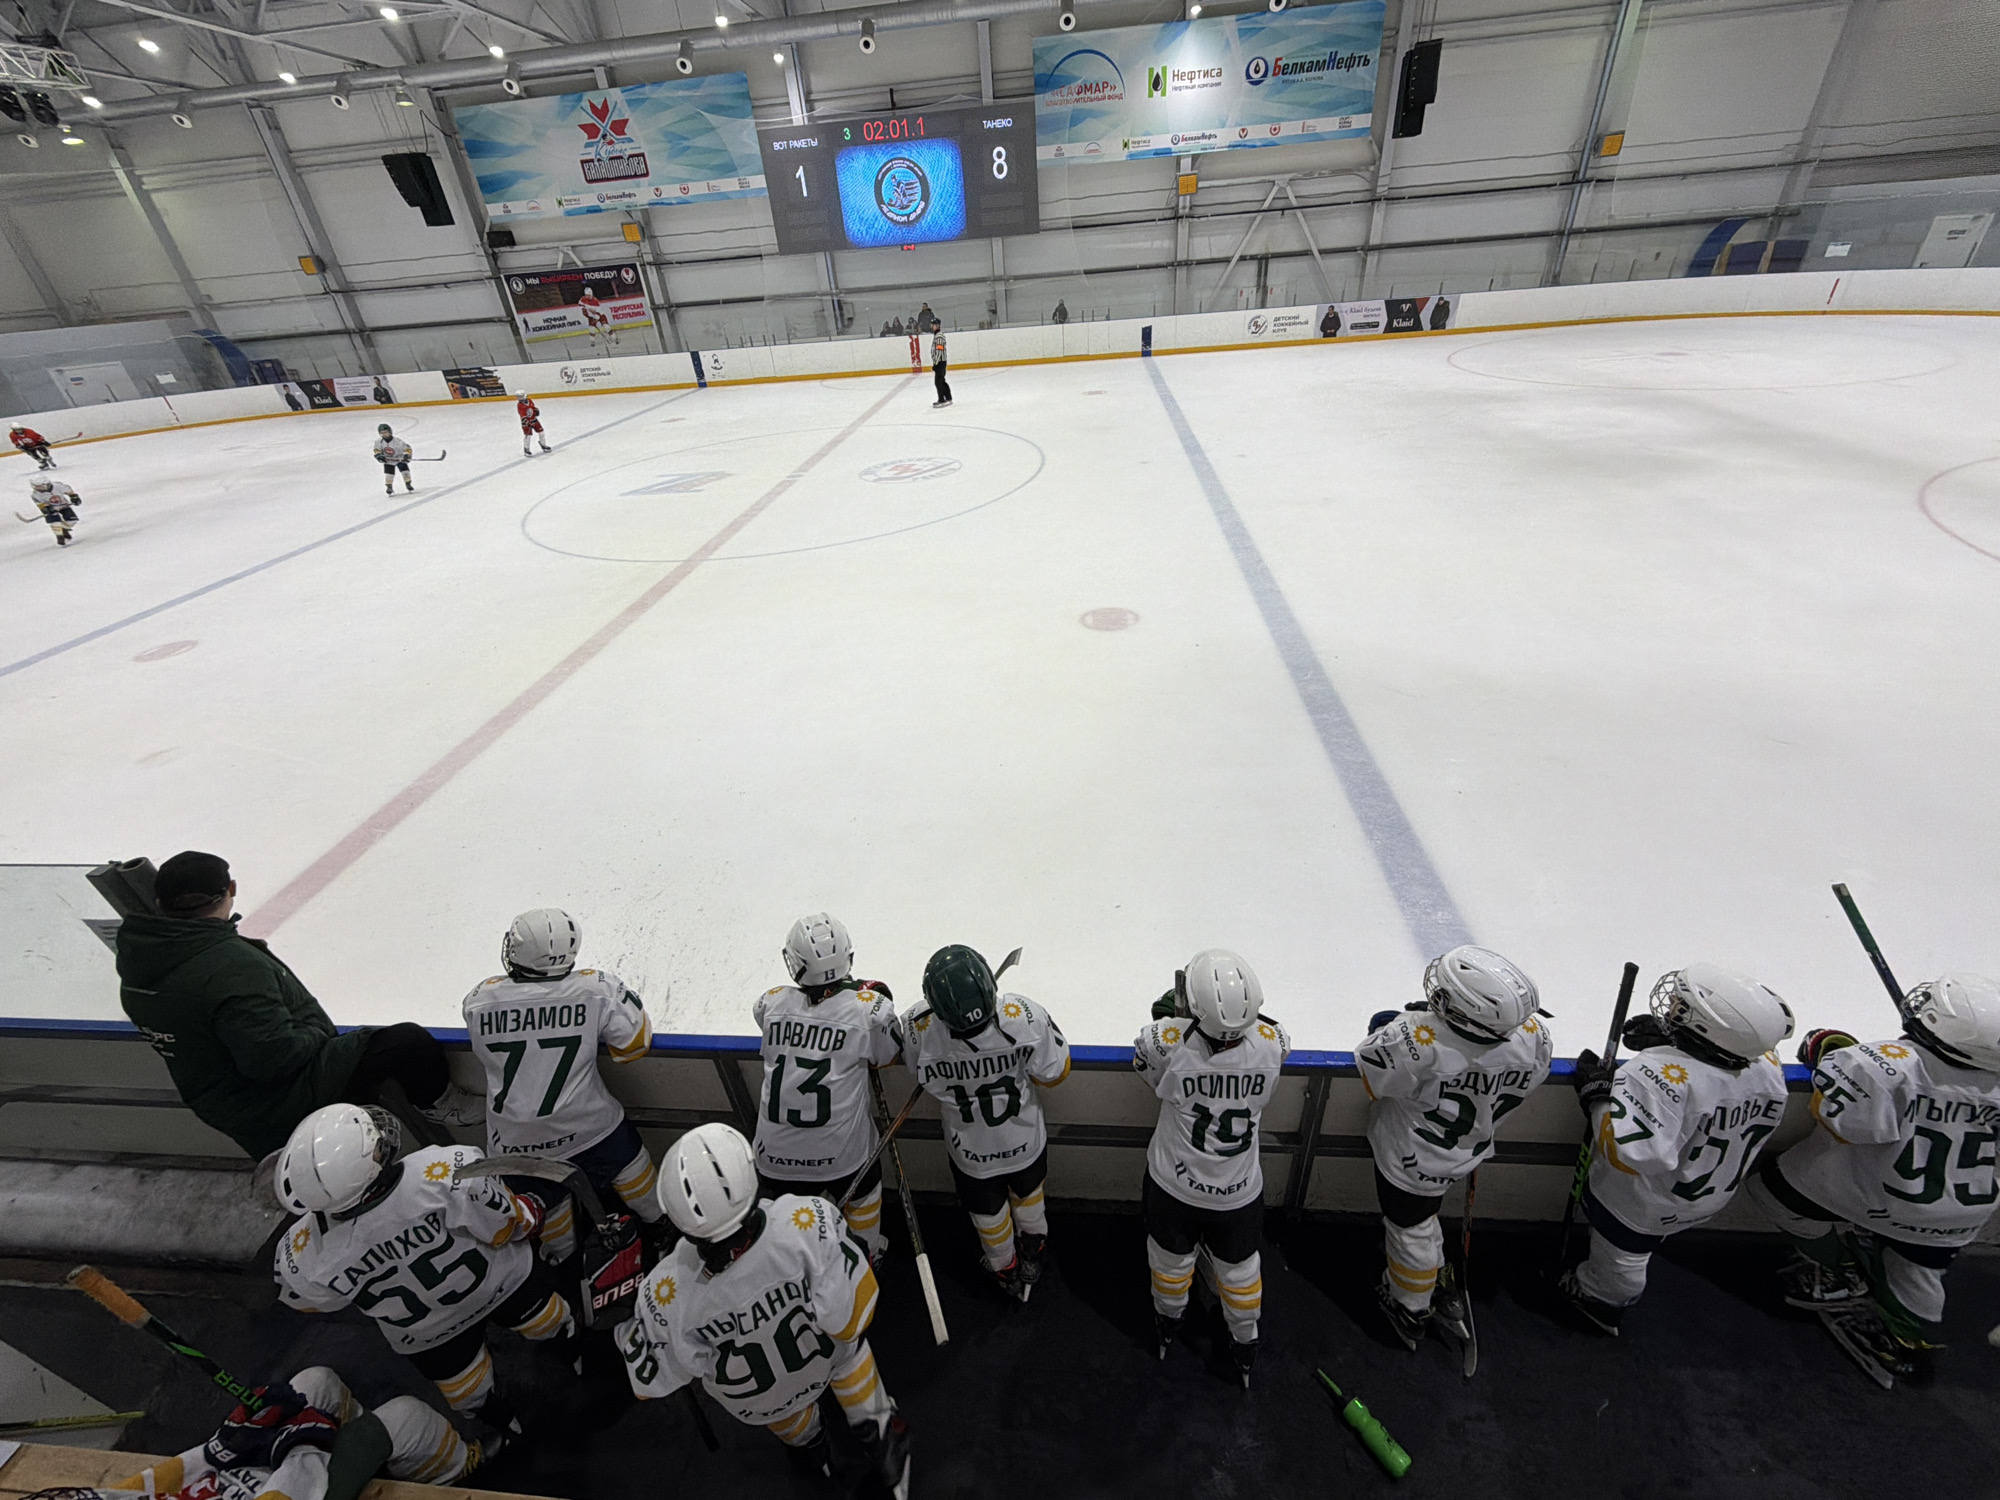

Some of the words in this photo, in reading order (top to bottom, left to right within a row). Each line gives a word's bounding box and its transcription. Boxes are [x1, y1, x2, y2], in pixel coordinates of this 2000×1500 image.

[1172, 66, 1223, 83] Нефтиса
[1272, 51, 1371, 77] БелкамНефть
[843, 128, 851, 140] 3
[982, 118, 1013, 130] ТАНЕКО
[773, 140, 788, 151] ВОТ
[789, 138, 819, 149] РАКЕТЫ
[992, 146, 1008, 179] 8
[795, 165, 808, 197] 1
[525, 277, 540, 285] МЫ
[584, 270, 618, 280] ПОБЕДУ!
[1392, 318, 1414, 328] Klaid
[548, 955, 567, 967] 77
[824, 968, 836, 982] 13
[480, 1003, 587, 1036] НИЗАМОВ
[965, 1007, 983, 1023] 10
[767, 1021, 847, 1052] ПАВЛОВ
[485, 1034, 583, 1118] 77
[1183, 1073, 1266, 1100] ОСИПОВ
[1830, 1063, 1871, 1100] TATNEFT
[767, 1054, 832, 1128] 13
[945, 1075, 1022, 1127] 10
[1622, 1088, 1665, 1130] TATNEFT
[1191, 1102, 1256, 1157] 19
[501, 1132, 578, 1155] TATNEFT
[962, 1142, 1029, 1163] TATNEFT
[767, 1155, 836, 1167] TATNEFT
[1883, 1124, 2000, 1206] 95
[1187, 1177, 1249, 1196] TATNEFT
[328, 1212, 441, 1296] САЛИХОВ
[716, 1305, 836, 1400] 96
